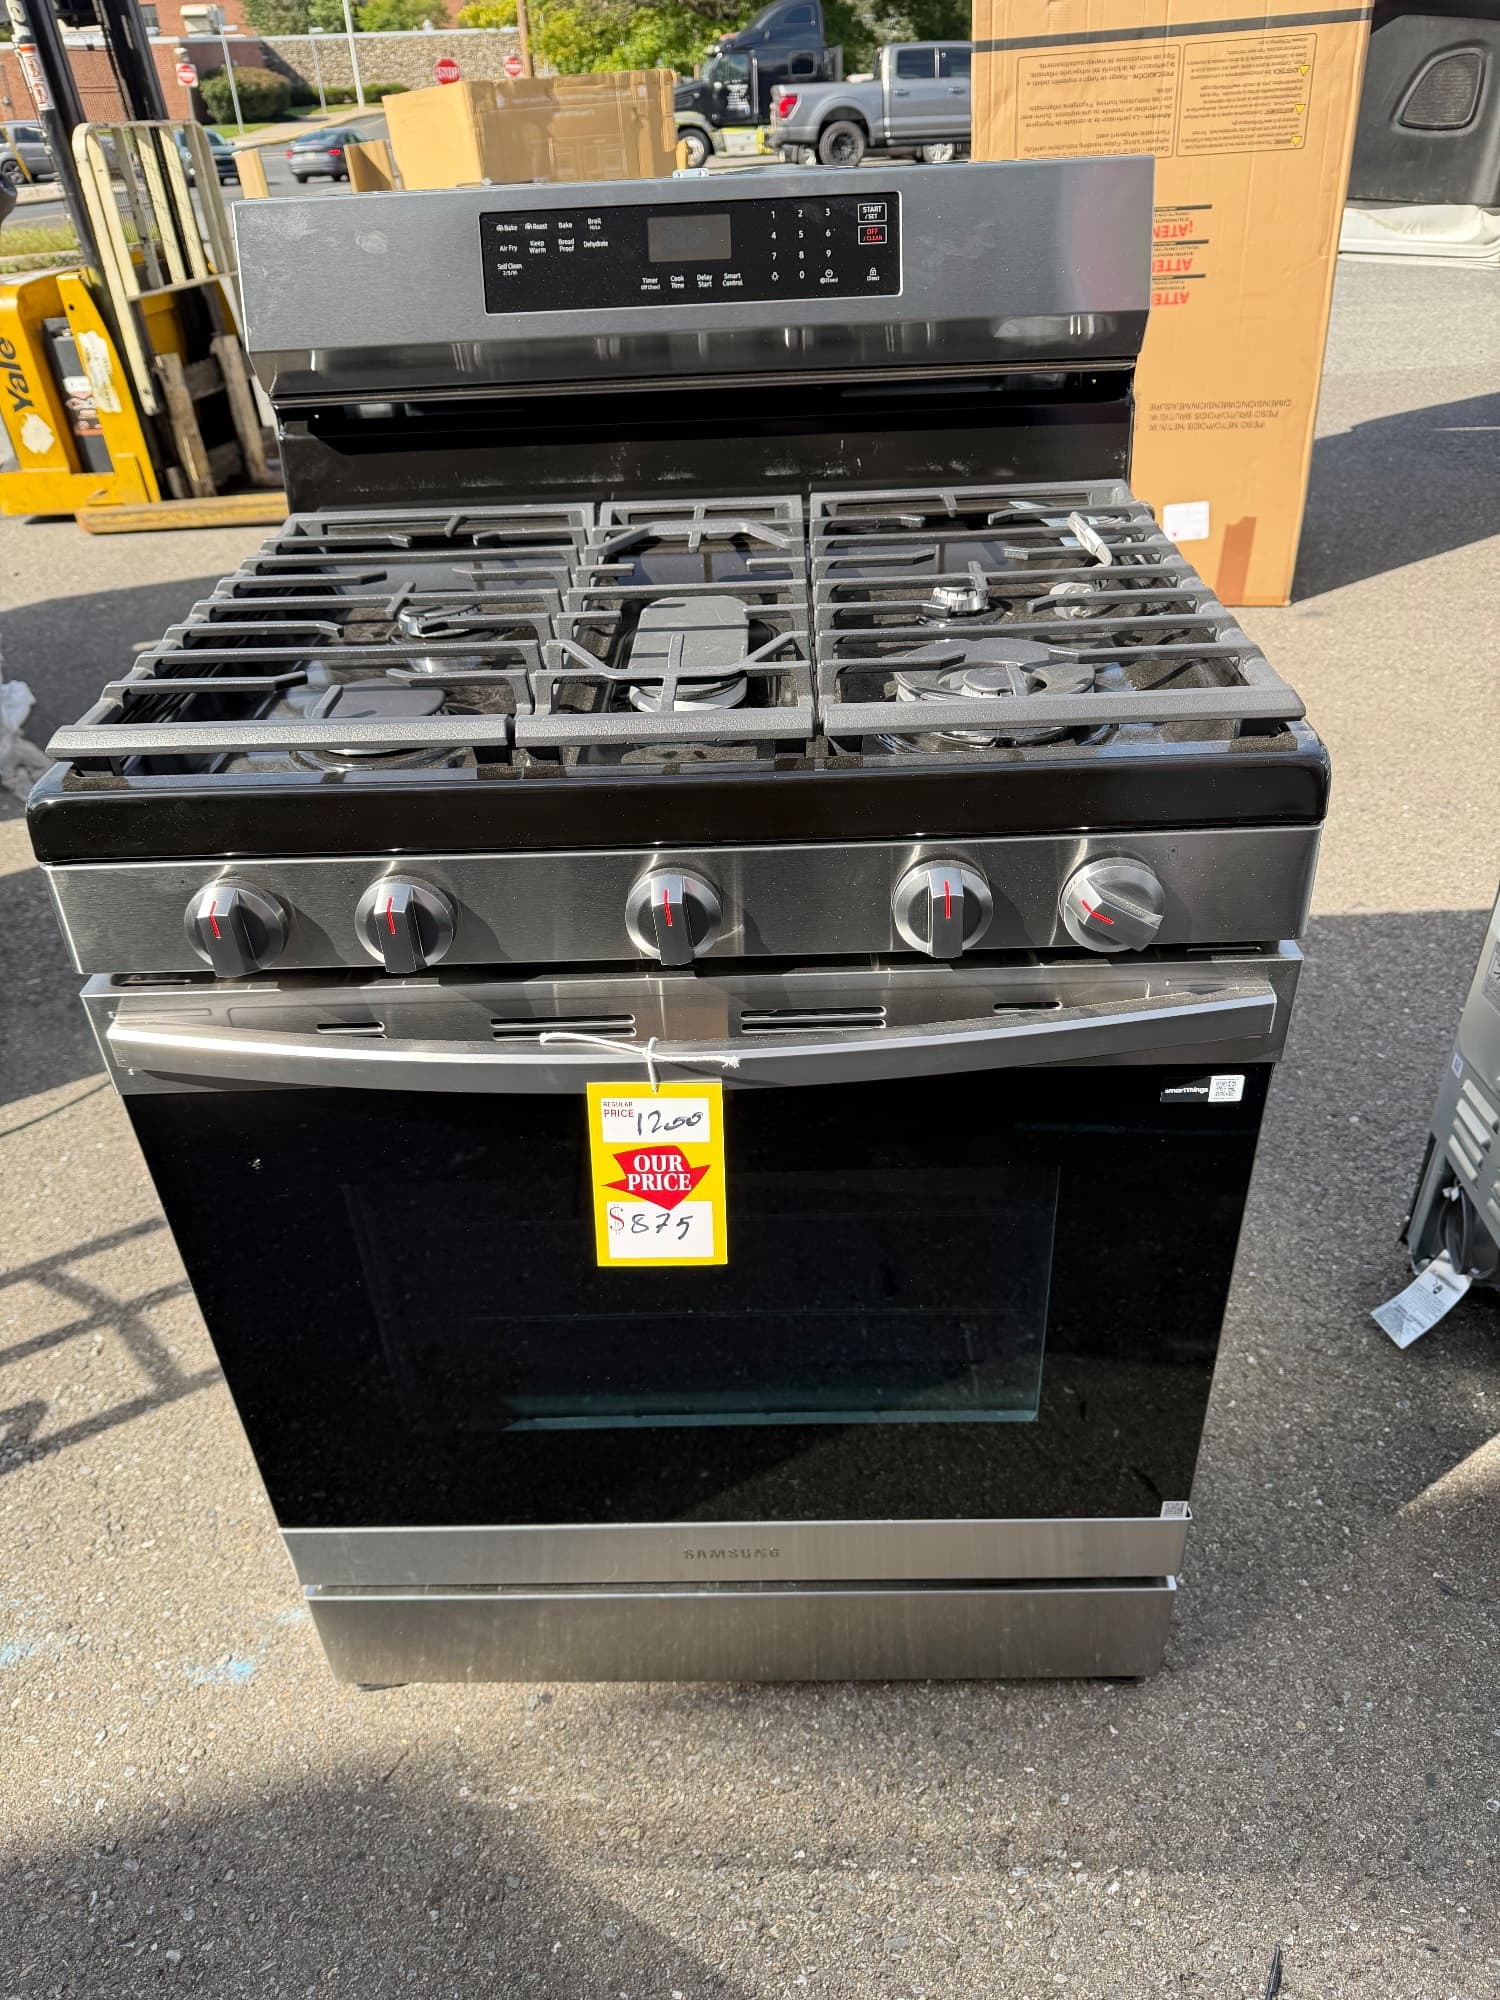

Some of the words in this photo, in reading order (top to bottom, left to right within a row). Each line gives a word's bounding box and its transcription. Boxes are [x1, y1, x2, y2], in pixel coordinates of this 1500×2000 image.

[770, 210, 776, 218] 1
[798, 210, 804, 218] 2
[825, 208, 830, 216] 3
[862, 206, 882, 214] START
[771, 232, 777, 240] 4
[798, 230, 804, 238] 5
[826, 229, 831, 237] 6
[558, 238, 574, 246] Bread
[500, 244, 508, 252] Air
[508, 244, 518, 254] Fry
[772, 252, 777, 260] 7
[799, 251, 804, 260] 8
[826, 250, 832, 258] 9
[1152, 258, 1193, 272] ATTE
[696, 274, 712, 282] Delay
[800, 271, 804, 280] 0
[0, 337, 34, 413] Yale
[604, 1109, 634, 1118] PRICE
[636, 1110, 704, 1136] 1200
[633, 1154, 684, 1172] OUR
[626, 1174, 692, 1192] PRICE
[683, 1548, 780, 1559] SAMSUNG
